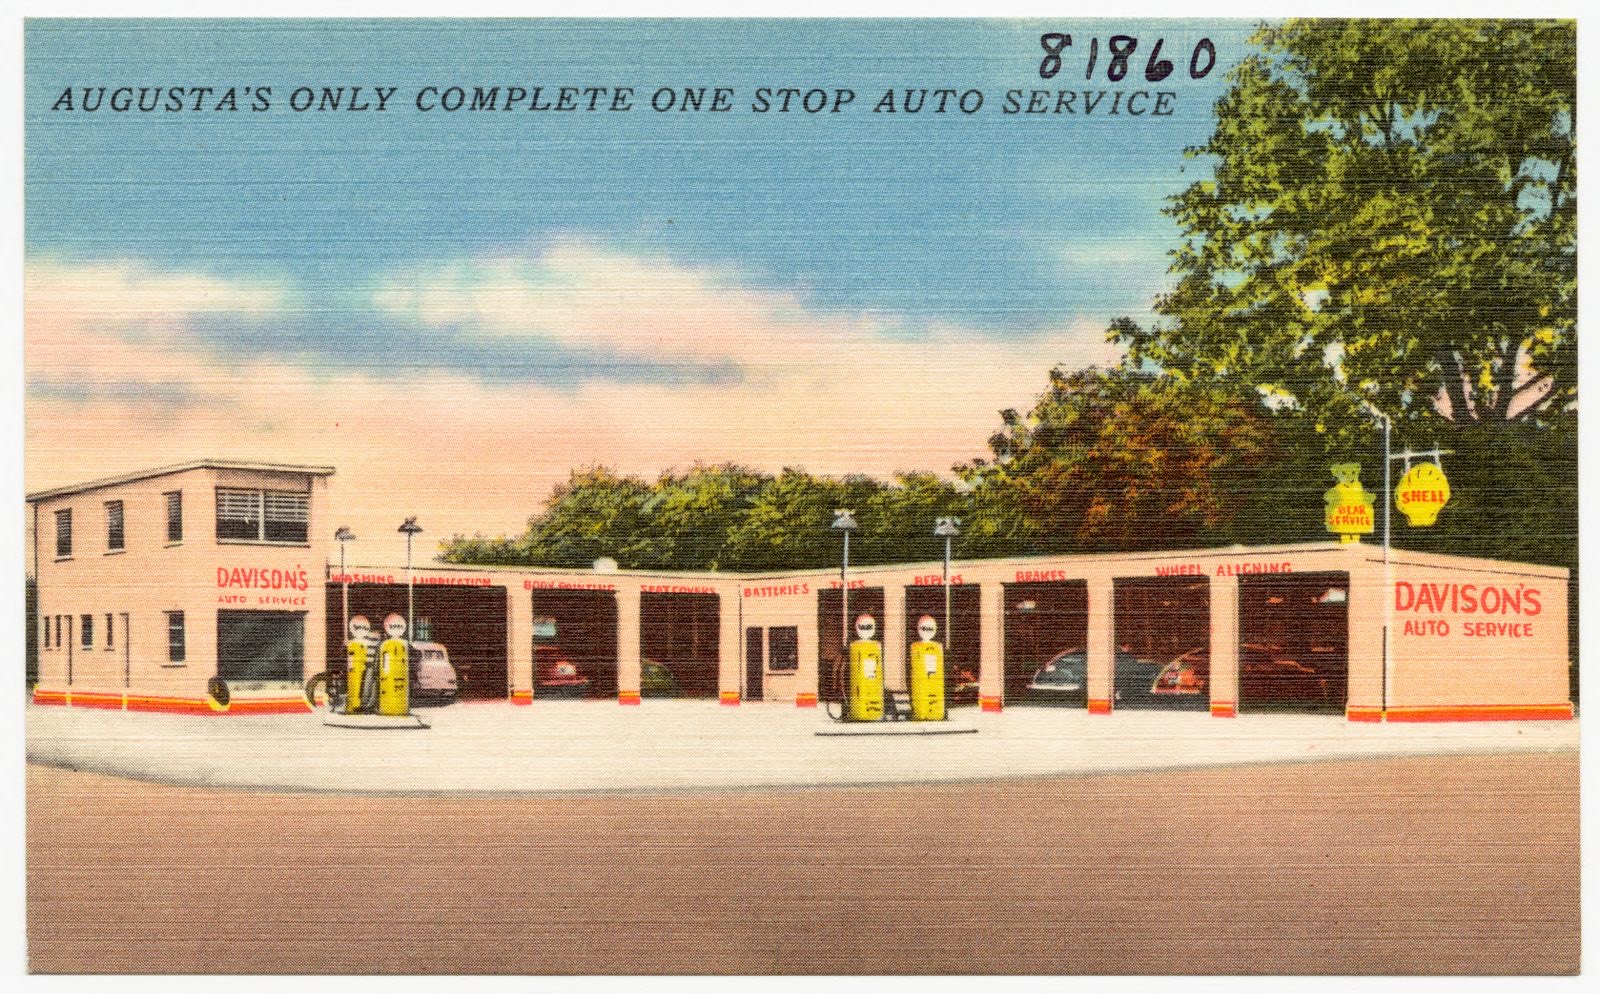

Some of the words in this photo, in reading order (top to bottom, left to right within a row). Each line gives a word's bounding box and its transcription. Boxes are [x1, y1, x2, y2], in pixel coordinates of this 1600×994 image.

[1038, 33, 1217, 82] 81860
[1401, 489, 1445, 504] SHELL
[1338, 504, 1366, 515] BEAR
[1329, 514, 1371, 526] SERVICE
[1015, 569, 1066, 583] BRAKES
[1154, 563, 1204, 577] WHEEL
[1216, 561, 1293, 577] ALIGNING
[216, 563, 309, 592] DAVISON'S
[331, 573, 395, 585] WASHING
[743, 583, 809, 598] BATTERIES
[218, 595, 247, 604] AUTO
[259, 596, 307, 606] SERVICE
[1394, 581, 1542, 617] DAVISON'S
[1403, 619, 1451, 638] AUTO
[1463, 621, 1534, 639] SERVICE
